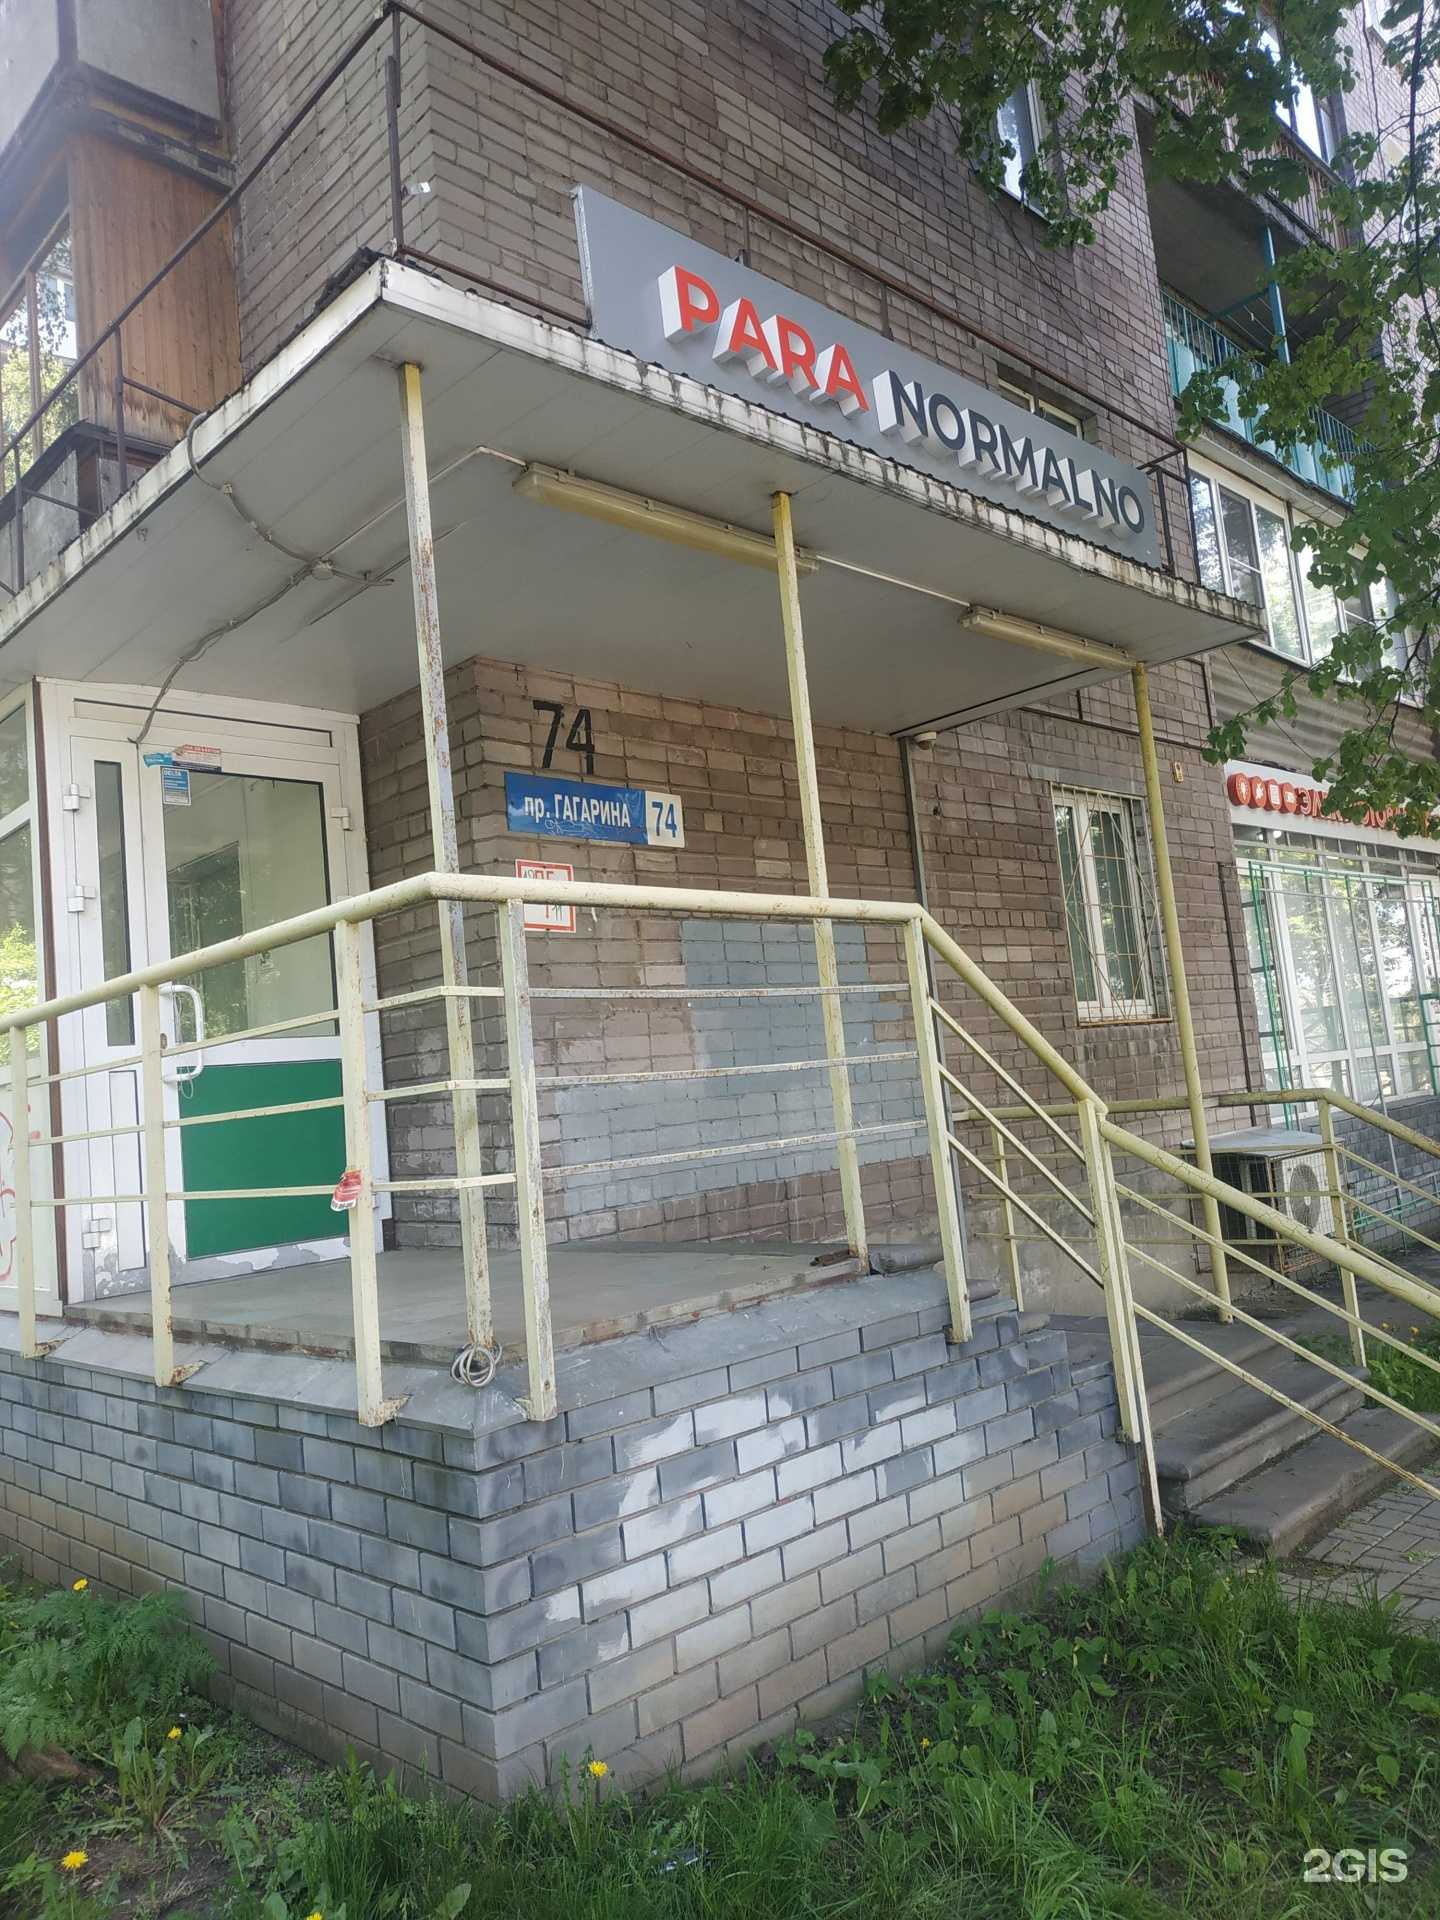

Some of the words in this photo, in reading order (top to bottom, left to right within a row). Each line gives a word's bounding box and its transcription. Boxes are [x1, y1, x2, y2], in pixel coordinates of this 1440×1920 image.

[664, 264, 870, 416] PARA
[880, 370, 1145, 536] NORMALNO
[532, 699, 596, 776] 74
[524, 796, 550, 824] пр.
[553, 793, 632, 829] ГАГАРИНА
[651, 801, 678, 838] 74
